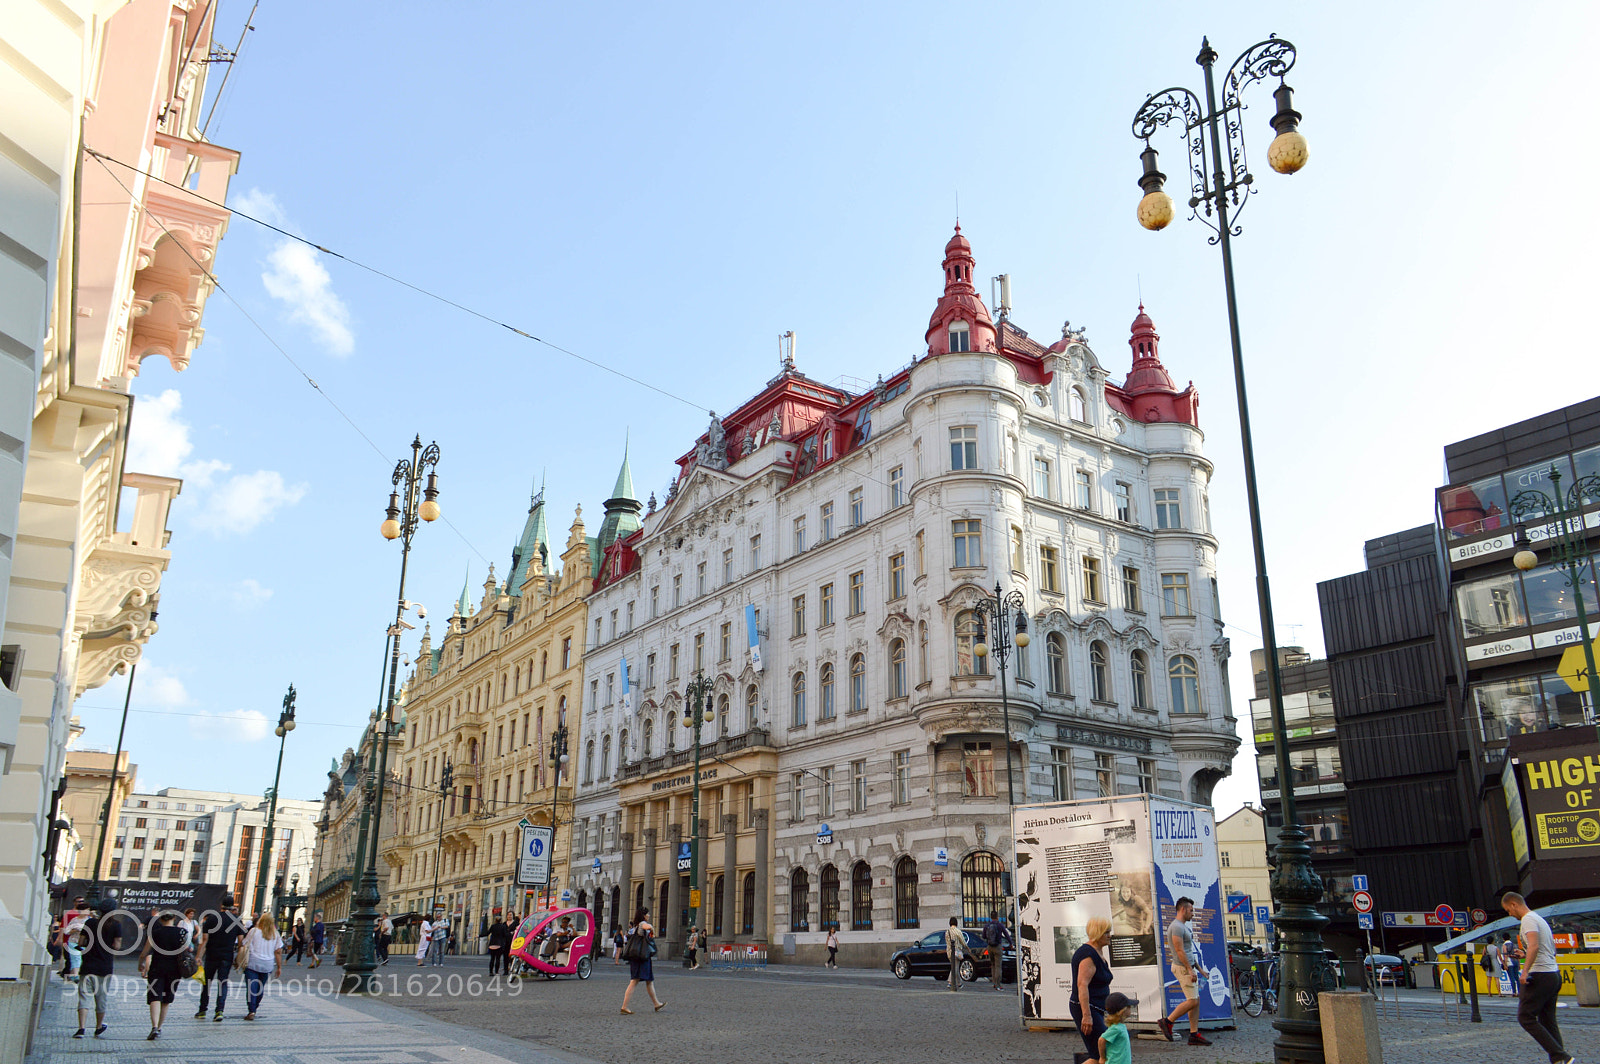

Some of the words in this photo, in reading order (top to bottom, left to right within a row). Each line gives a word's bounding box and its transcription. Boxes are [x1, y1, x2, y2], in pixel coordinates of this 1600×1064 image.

[1518, 467, 1558, 487] CAF
[1460, 540, 1503, 557] BIBLOO
[1554, 630, 1582, 645] play.
[1482, 643, 1515, 656] zetko.
[1058, 726, 1153, 751] MELANTRICH
[1565, 789, 1593, 808] OF
[1023, 819, 1049, 829] Jiřina
[1049, 812, 1092, 826] Dostálová
[1154, 807, 1198, 840] HVĚZDA
[1547, 815, 1580, 824] ROOFTOP
[1549, 827, 1568, 835] BEER
[816, 836, 832, 845] ČSOB
[1550, 836, 1580, 845] GARDEN
[123, 888, 159, 898] Kavárna
